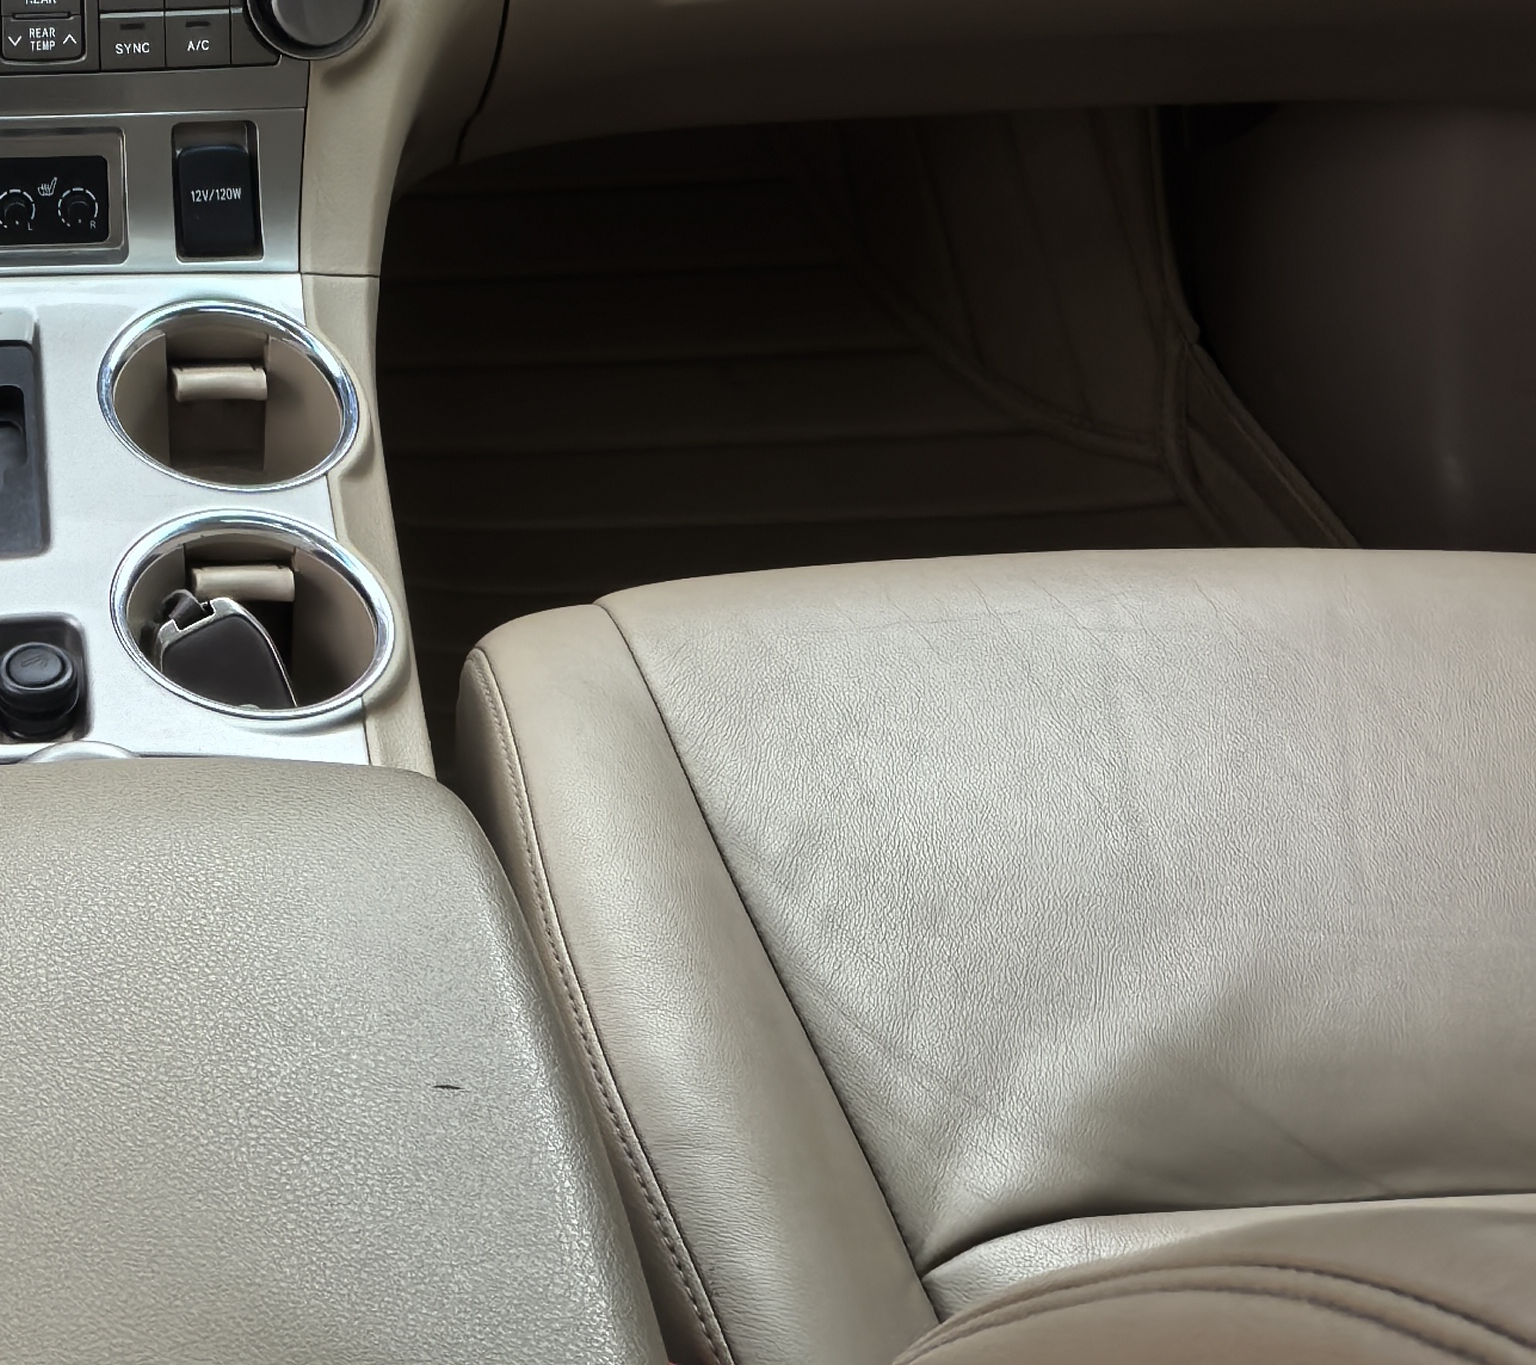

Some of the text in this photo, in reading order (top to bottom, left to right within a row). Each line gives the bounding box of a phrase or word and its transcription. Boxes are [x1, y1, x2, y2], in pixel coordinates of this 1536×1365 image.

[28, 27, 56, 38] REAR
[30, 40, 56, 52] TEMP
[115, 42, 151, 55] SYNC
[187, 40, 210, 52] A/C
[190, 187, 242, 203] 12V/120W
